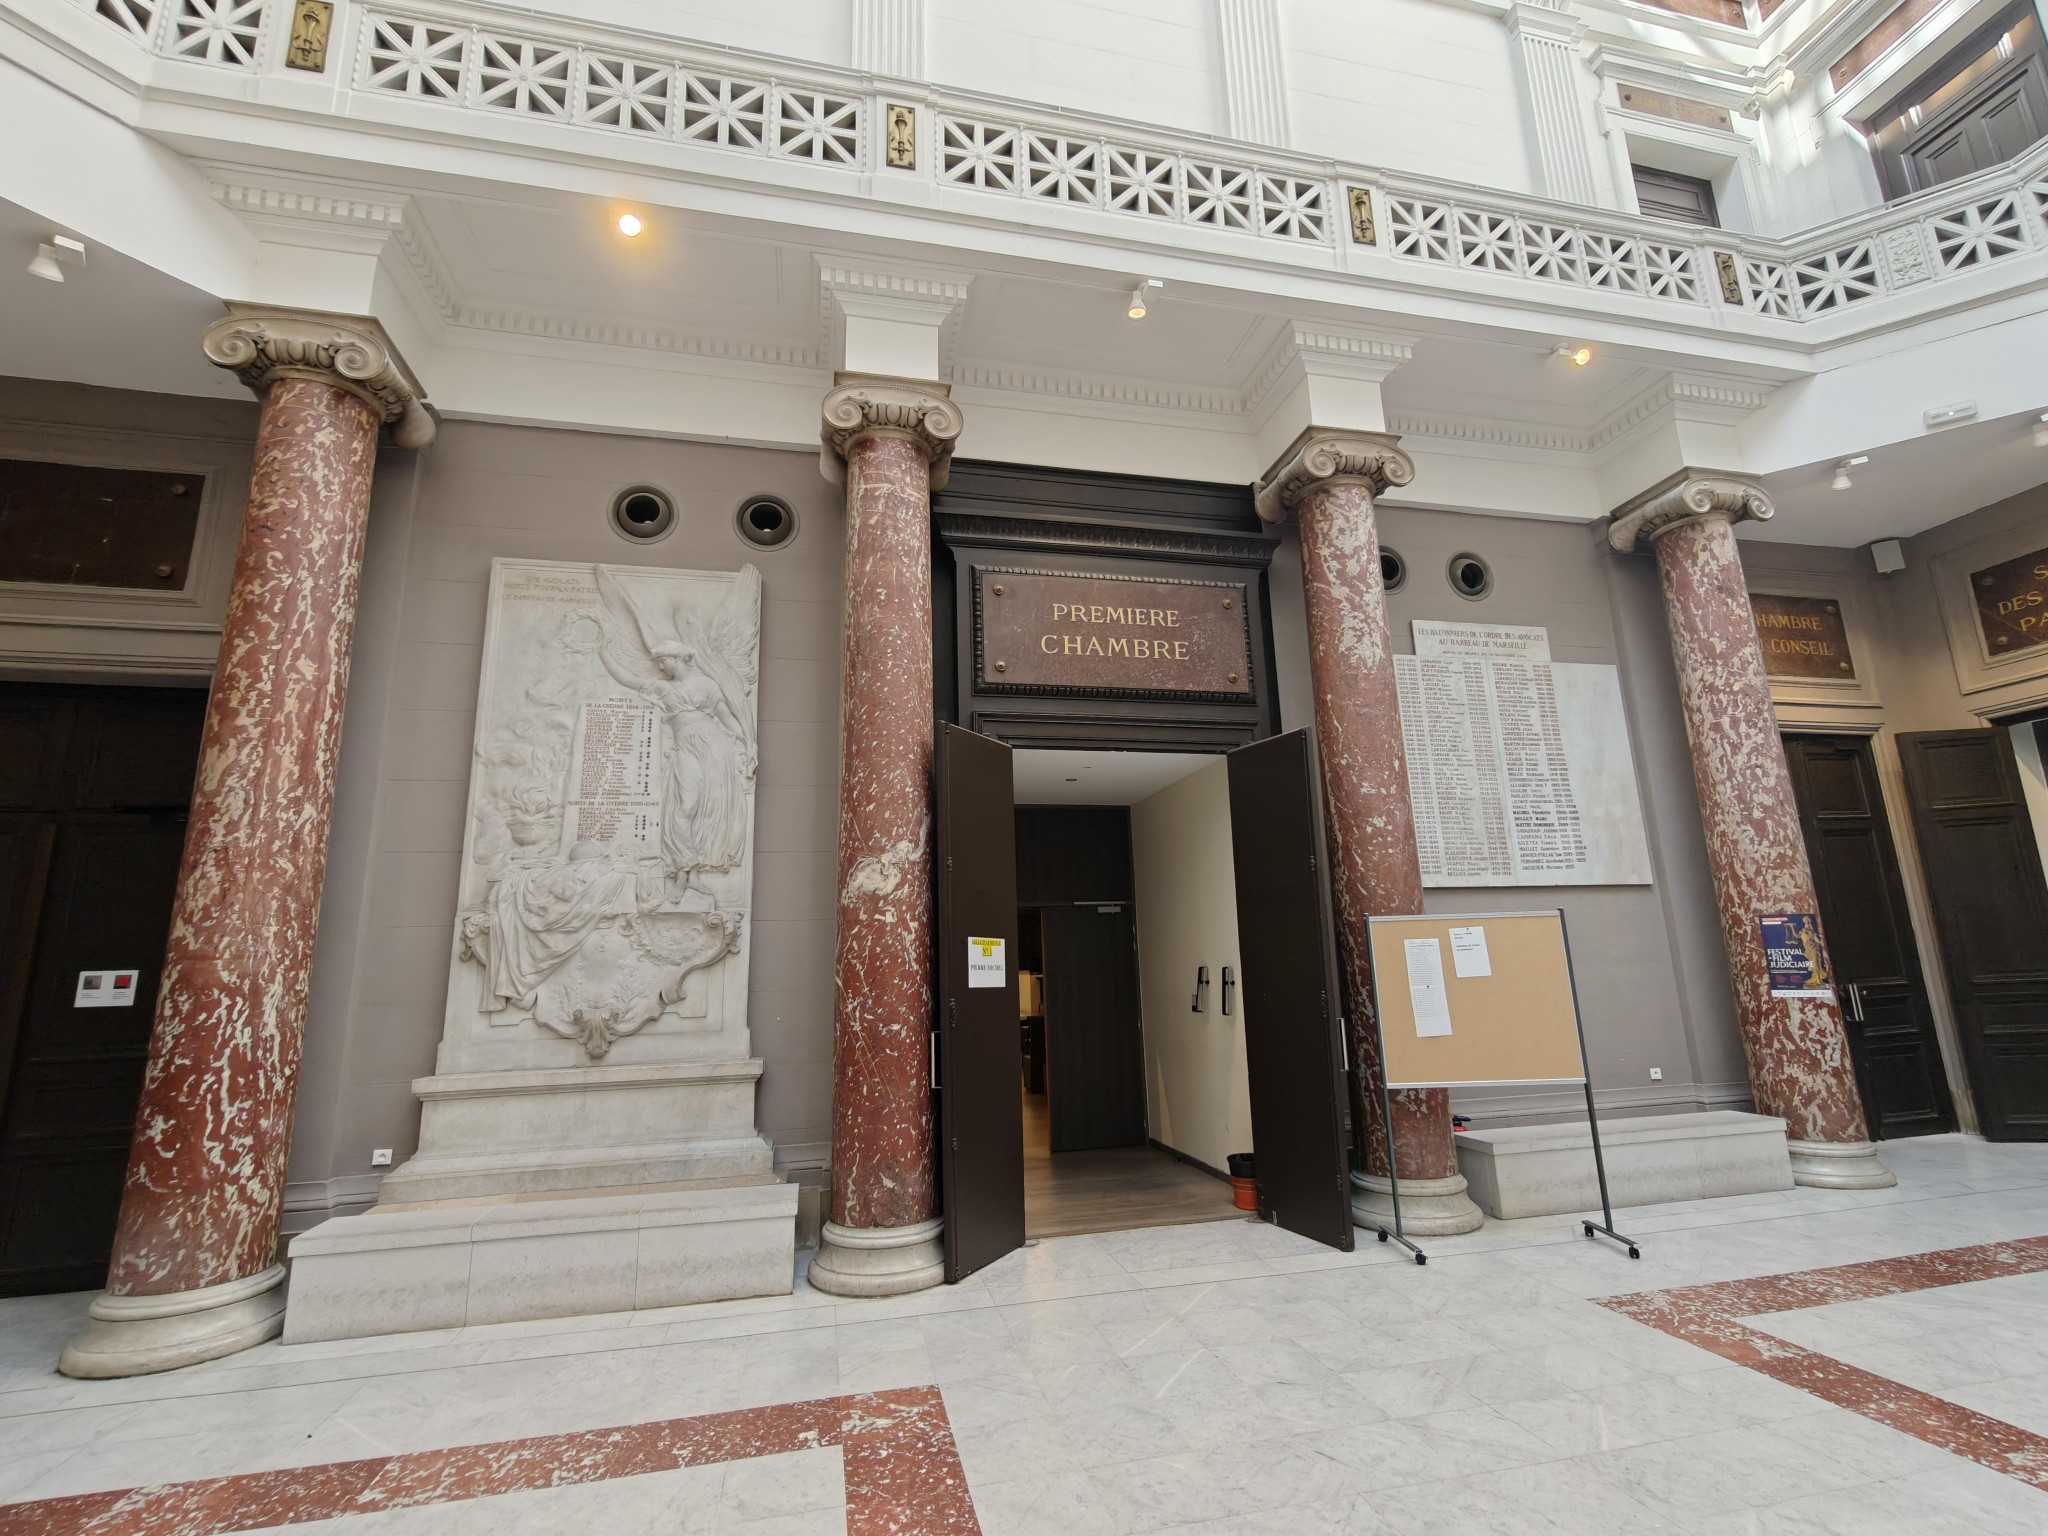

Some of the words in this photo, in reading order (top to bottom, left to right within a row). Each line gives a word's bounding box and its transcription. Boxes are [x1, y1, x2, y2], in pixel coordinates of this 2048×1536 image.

[1997, 591, 2043, 615] DES
[1052, 604, 1180, 628] PREMIERE
[1755, 613, 1822, 630] HAMBRE
[1040, 635, 1190, 660] CHAMBRE
[1451, 639, 1480, 647] BARREAU
[1492, 641, 1528, 649] MARSEILLE
[1772, 639, 1833, 656] CONSEIL
